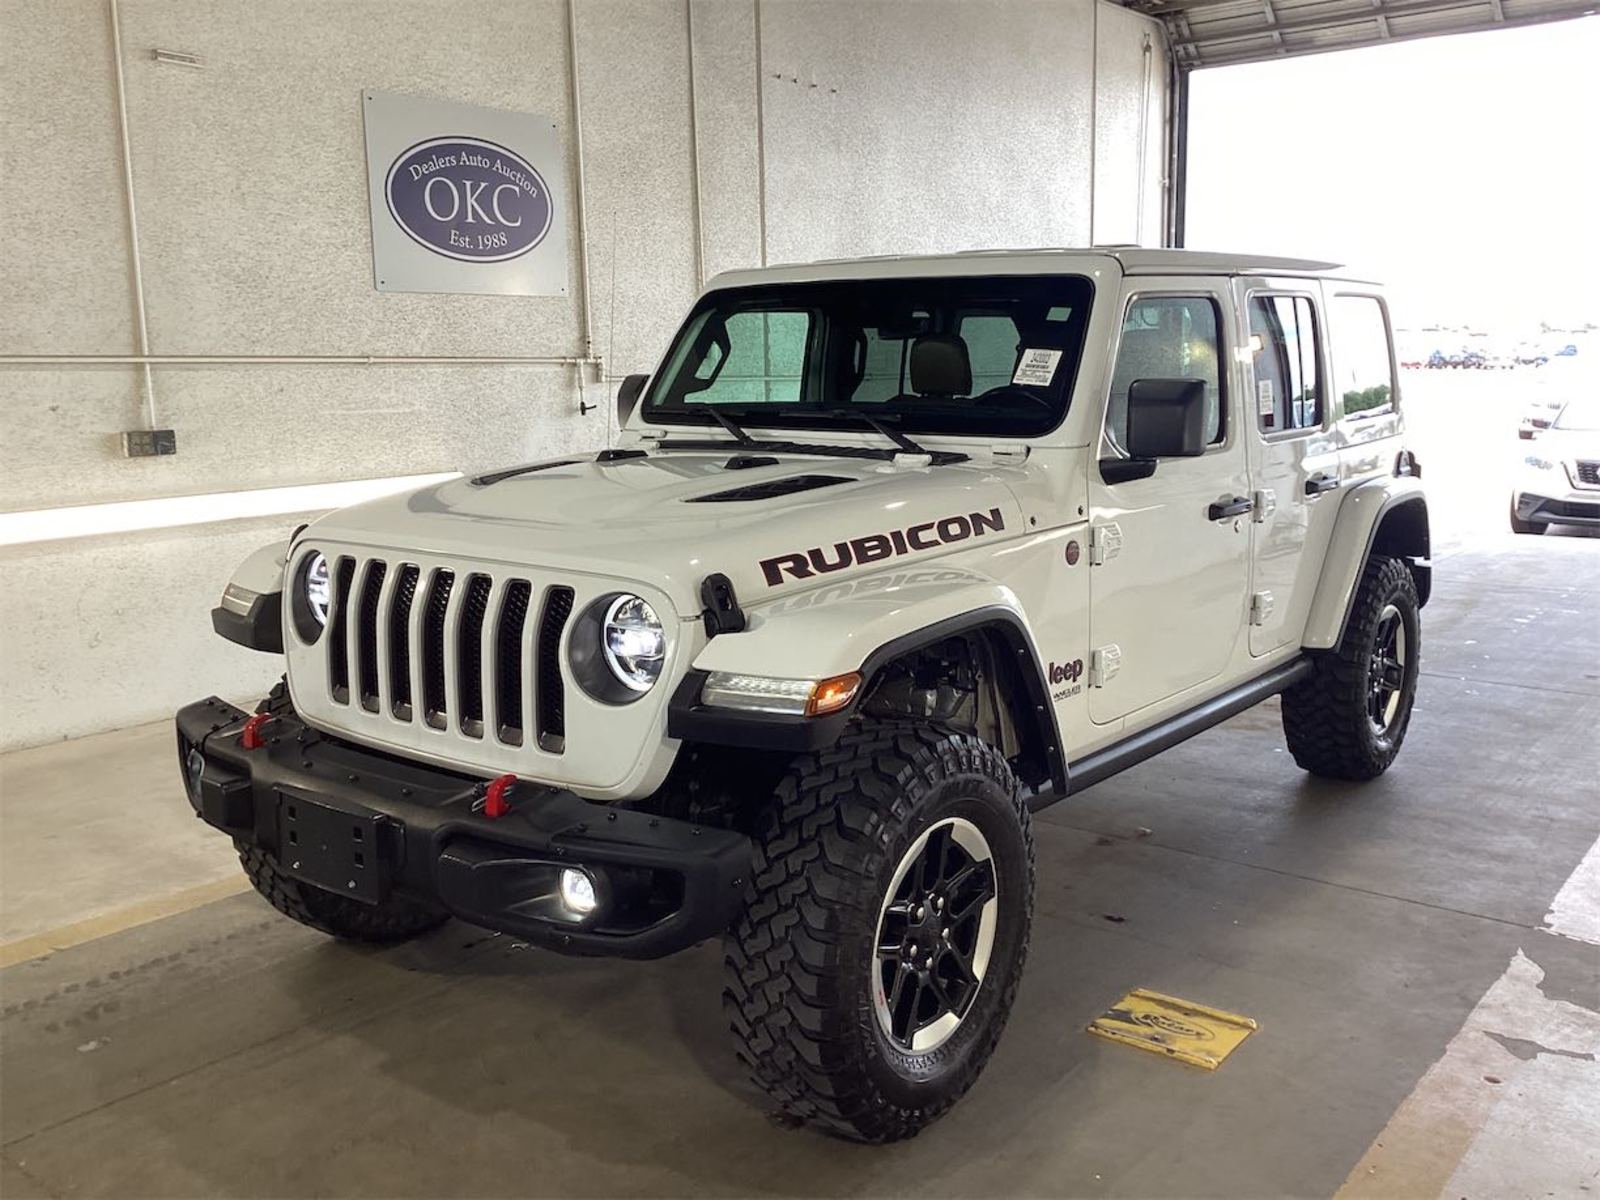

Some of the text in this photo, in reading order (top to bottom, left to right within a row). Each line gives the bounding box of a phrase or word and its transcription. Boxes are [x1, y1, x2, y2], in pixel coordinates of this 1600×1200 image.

[409, 151, 538, 198] Dealers Auto Auction
[424, 176, 522, 227] OKC
[449, 229, 508, 250] Est. 1988
[759, 508, 1005, 587] RUBICON
